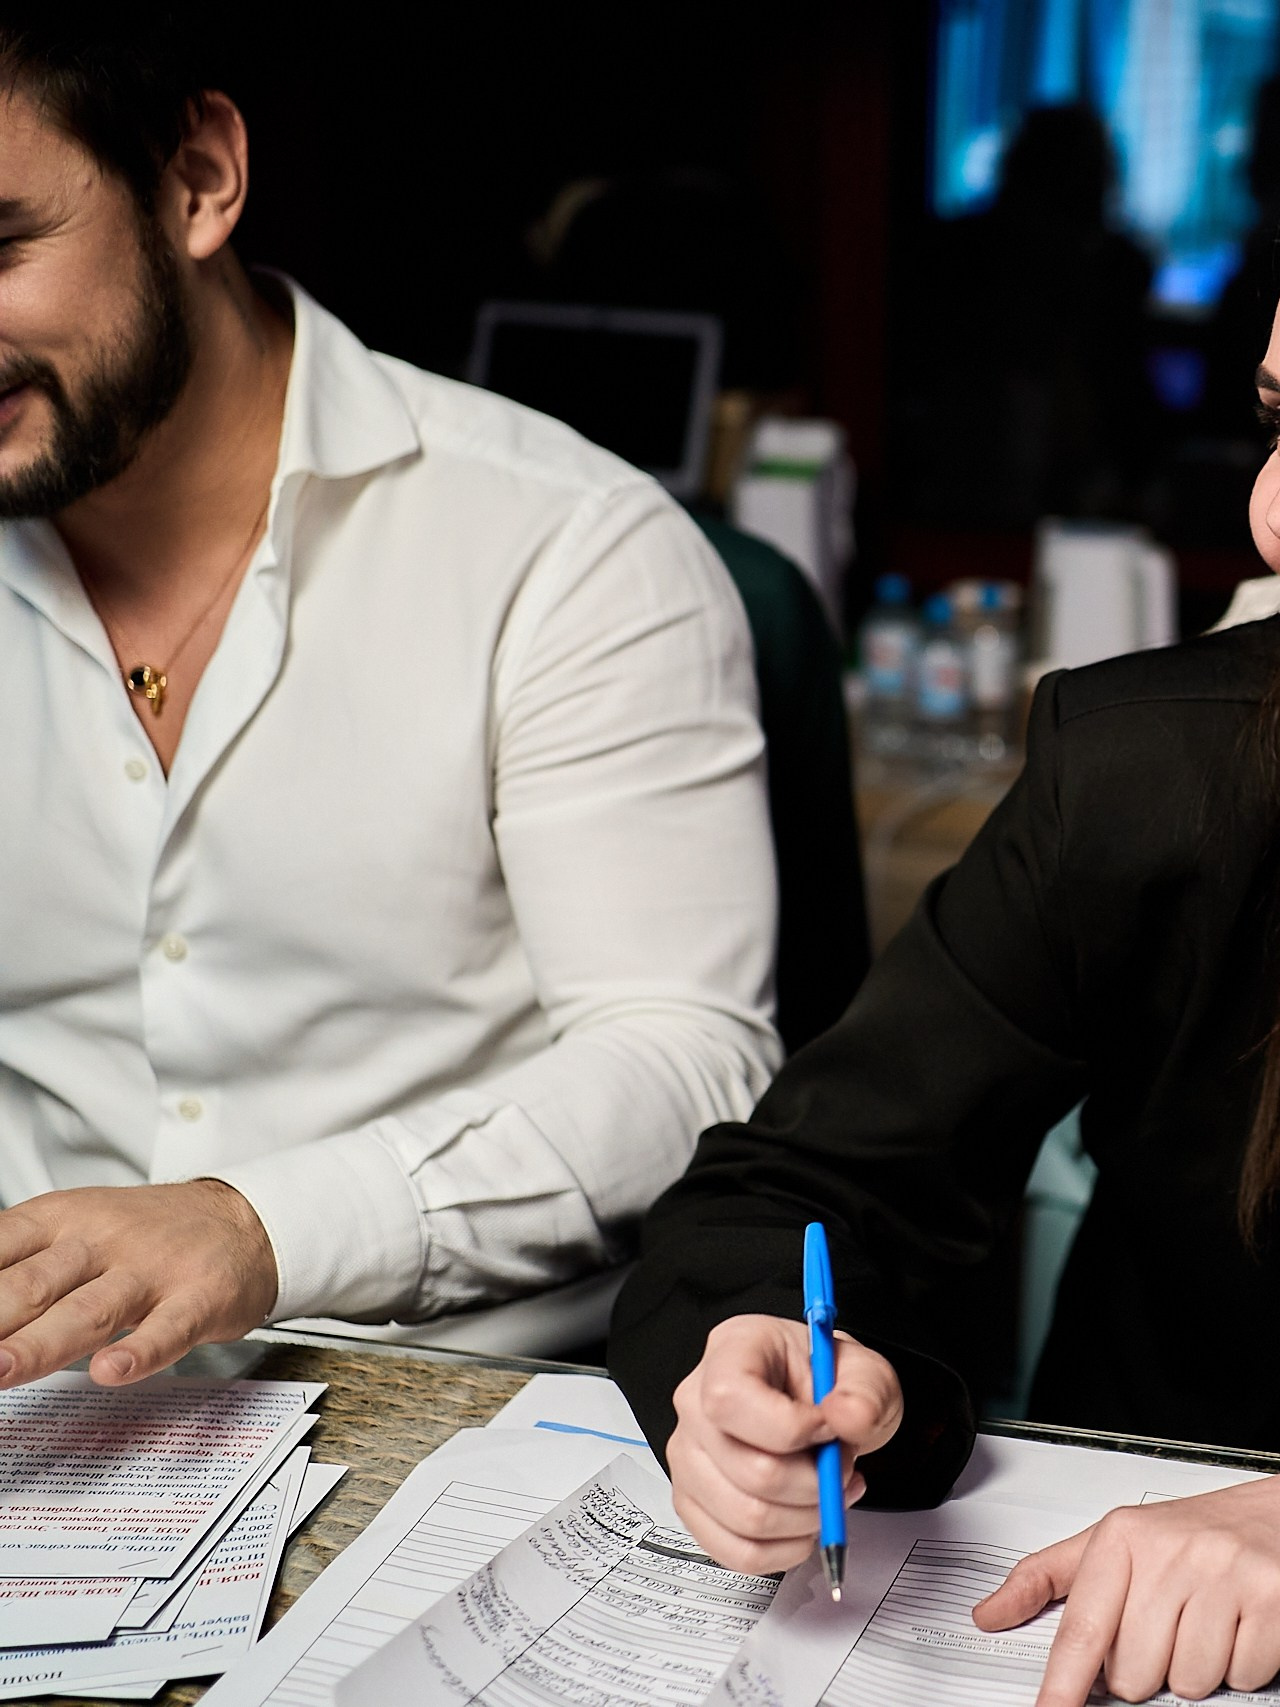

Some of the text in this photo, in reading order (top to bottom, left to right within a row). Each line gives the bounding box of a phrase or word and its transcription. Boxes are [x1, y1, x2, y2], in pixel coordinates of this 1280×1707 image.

[169, 1432, 212, 1440] чёрной
[26, 1453, 141, 1461] соответствующего
[170, 1449, 213, 1457] Чёрная
[43, 1470, 104, 1479] Шмакова,
[88, 1490, 165, 1498] Благодарим
[249, 1524, 273, 1532] 200
[220, 1542, 269, 1552] людям
[230, 1562, 264, 1572] одну
[693, 1565, 733, 1578] НОСОВ
[216, 1572, 260, 1584] ЮЛЯ:
[82, 1587, 122, 1596] ЮЛЯ:
[747, 1603, 768, 1612] ОВА
[184, 1626, 247, 1640] ИГОРЬ:
[911, 1627, 946, 1637] DeLuxe
[166, 1634, 178, 1642] И
[0, 1672, 63, 1686] НОМИ
